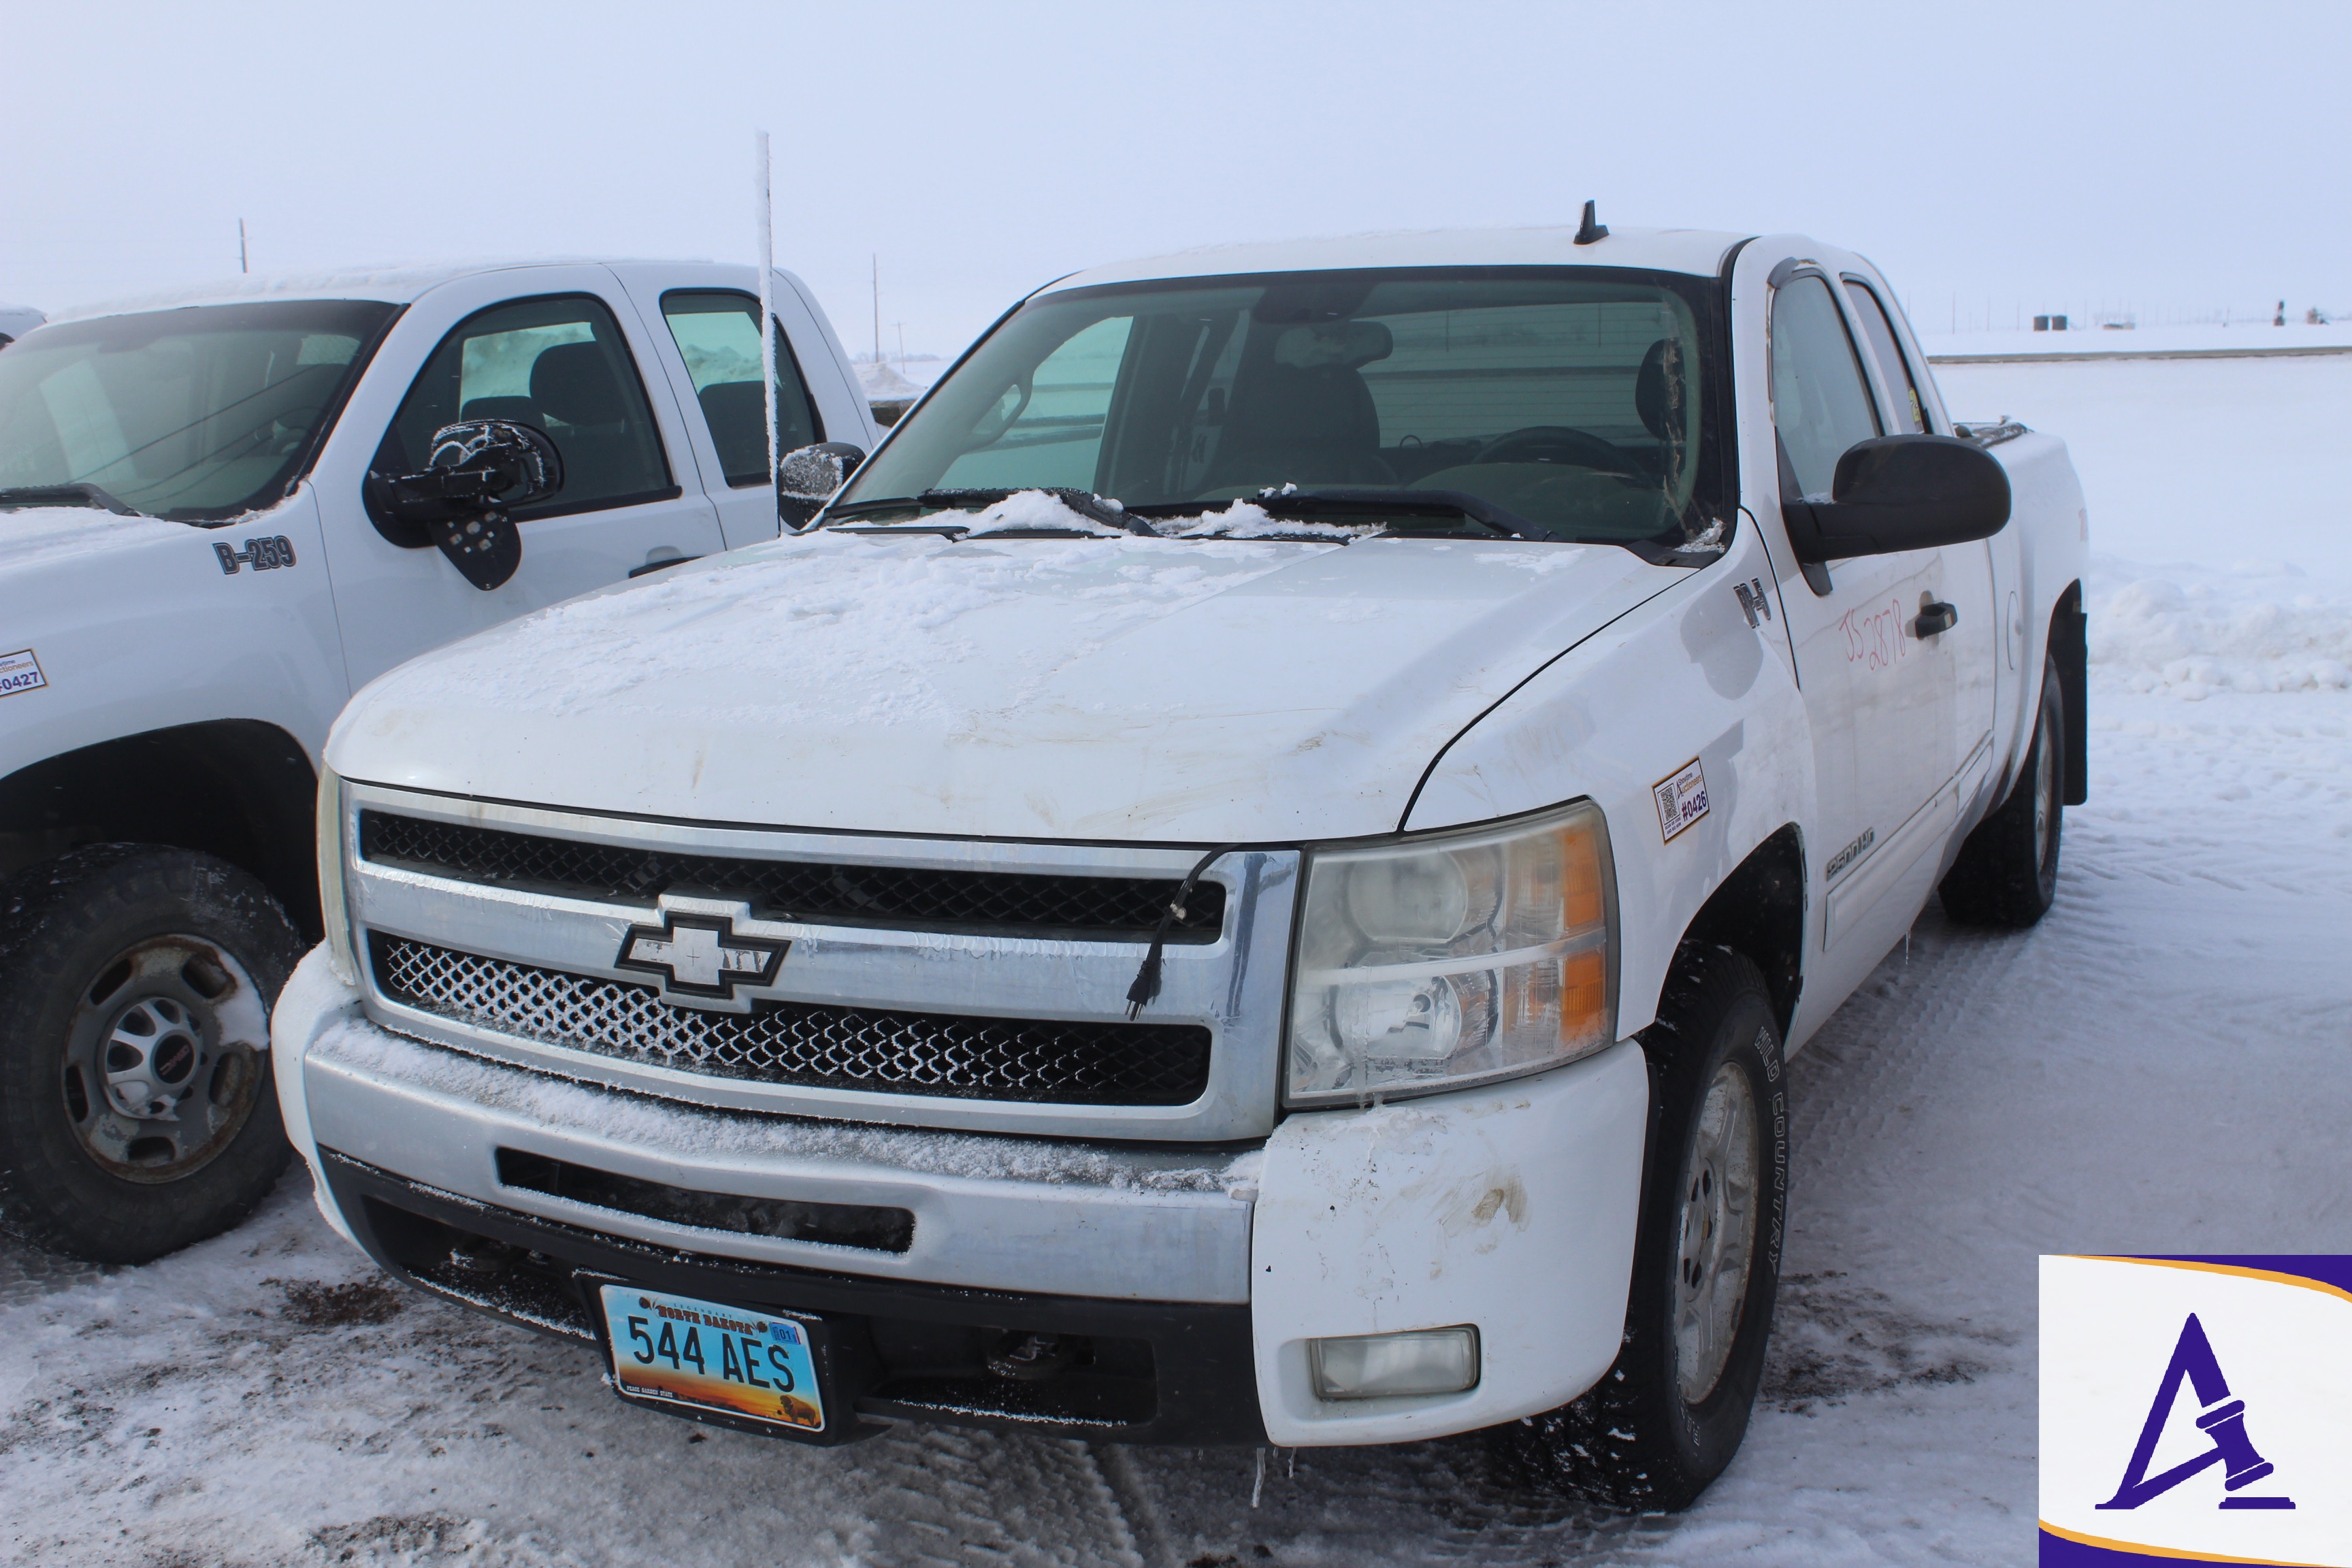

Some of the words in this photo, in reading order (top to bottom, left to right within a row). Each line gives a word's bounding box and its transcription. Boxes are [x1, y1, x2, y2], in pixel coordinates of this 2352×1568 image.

[212, 535, 297, 575] B-259
[1682, 790, 1707, 822] #0426
[1754, 1026, 1780, 1083] WILD
[1768, 1092, 1786, 1276] COUNTRY
[656, 1305, 701, 1325] NORTH
[703, 1313, 753, 1336] DAKOTA
[674, 1303, 733, 1319] LEGENDARY
[779, 1329, 791, 1340] 01
[627, 1315, 705, 1375] 544
[721, 1332, 795, 1393] AES
